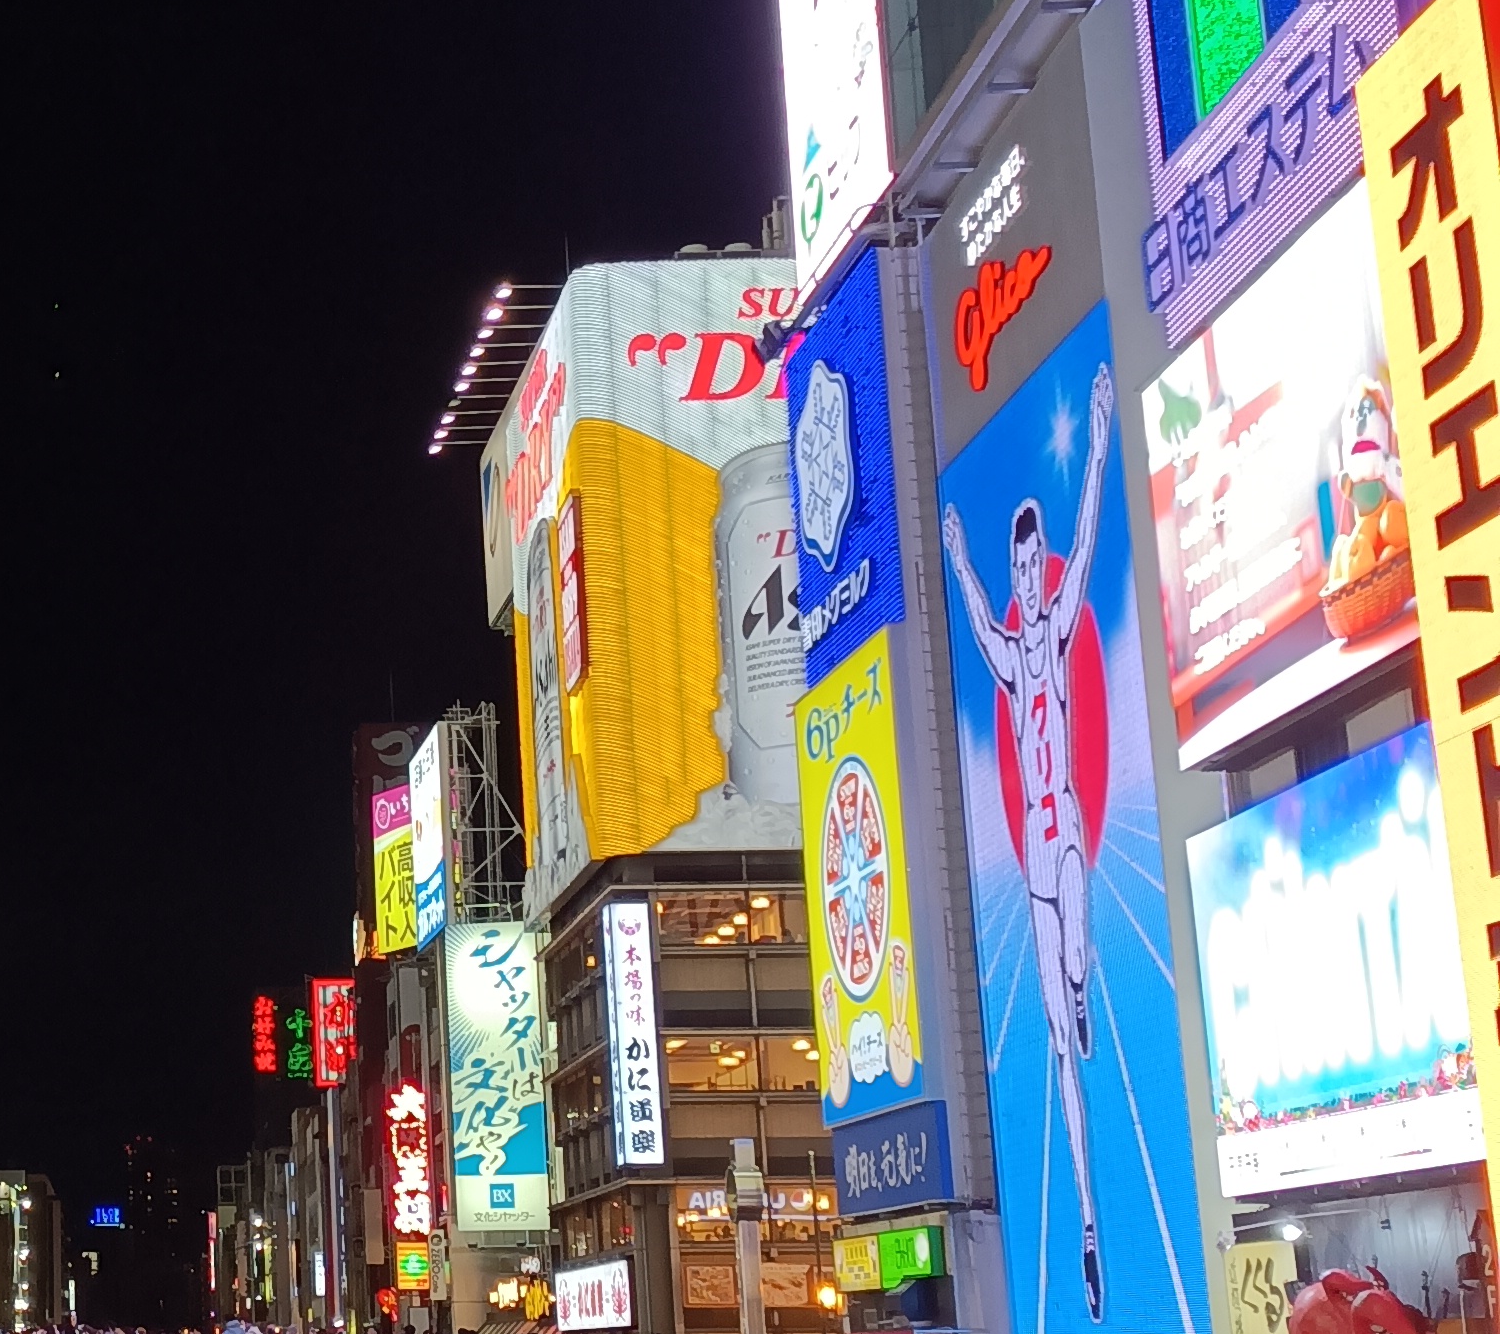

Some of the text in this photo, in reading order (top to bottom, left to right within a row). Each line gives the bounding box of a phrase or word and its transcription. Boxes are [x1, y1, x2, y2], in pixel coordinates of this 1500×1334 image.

[954, 244, 1052, 392] Glico
[801, 557, 870, 652] 雪印メグミルク
[380, 845, 397, 948] バイト
[622, 944, 645, 1026] 本場の味
[492, 1189, 513, 1203] BX
[431, 1248, 443, 1274] ZERO
